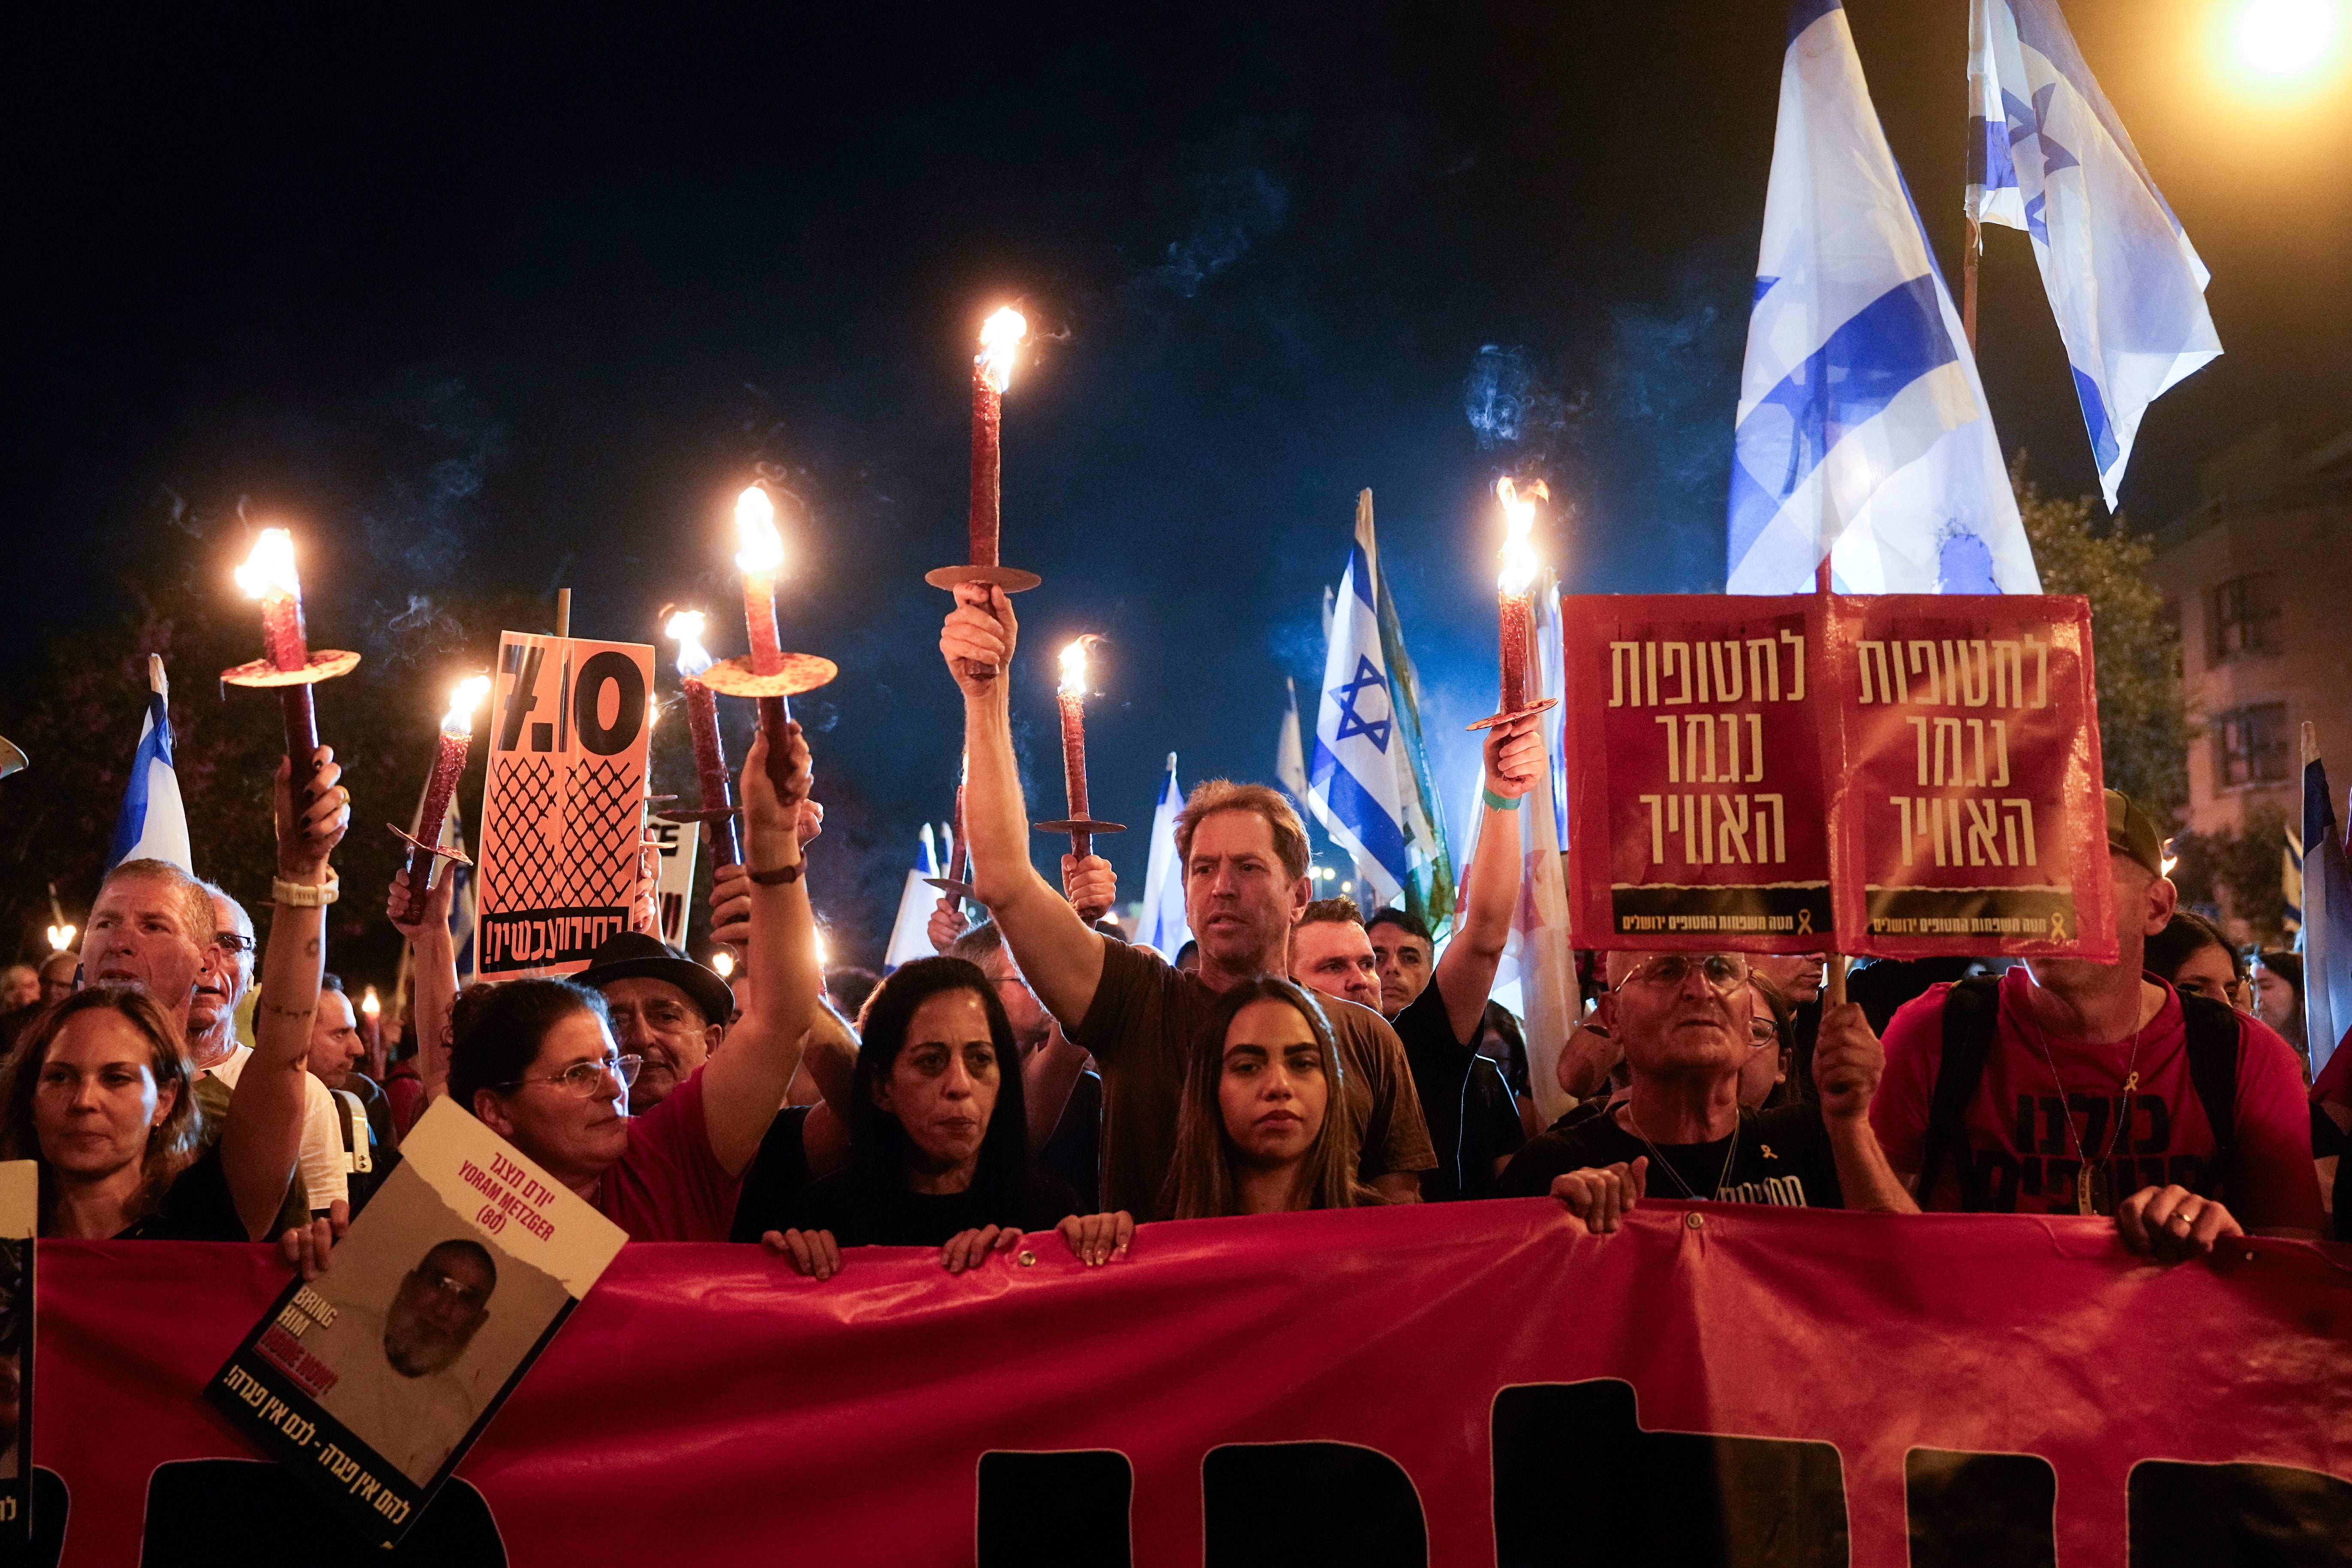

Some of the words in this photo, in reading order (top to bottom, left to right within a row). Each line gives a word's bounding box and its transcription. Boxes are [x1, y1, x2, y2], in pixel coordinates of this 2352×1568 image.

[1609, 629, 1805, 707] לחטופות
[1856, 633, 2047, 709] לחטופות
[1655, 713, 1763, 782] נגמר
[1906, 716, 2010, 787] נגמר
[1639, 793, 1786, 864] האוויר
[1889, 797, 2036, 867] האוויר
[485, 919, 558, 964] עכשיו!
[1622, 914, 1666, 930] ירושלים
[1668, 915, 1717, 930] החטופים
[1719, 915, 1766, 930] משפחות
[1769, 915, 1793, 930] מטה
[2017, 1093, 2171, 1156] כולנו
[490, 1152, 526, 1189] מצגר
[458, 1160, 503, 1201] YORAM
[498, 1192, 555, 1241] METZGER
[521, 1179, 555, 1207] יורם
[476, 1204, 507, 1235] (80)
[278, 1305, 311, 1337] HIM
[293, 1286, 338, 1328] BRING
[260, 1323, 306, 1367] HOME
[296, 1352, 339, 1394] NOW!
[223, 1364, 269, 1407] פגרה!
[258, 1396, 289, 1425] אין
[281, 1412, 316, 1445] לכם
[318, 1443, 361, 1483] פגרה
[350, 1471, 381, 1501] אין
[373, 1488, 411, 1524] להם
